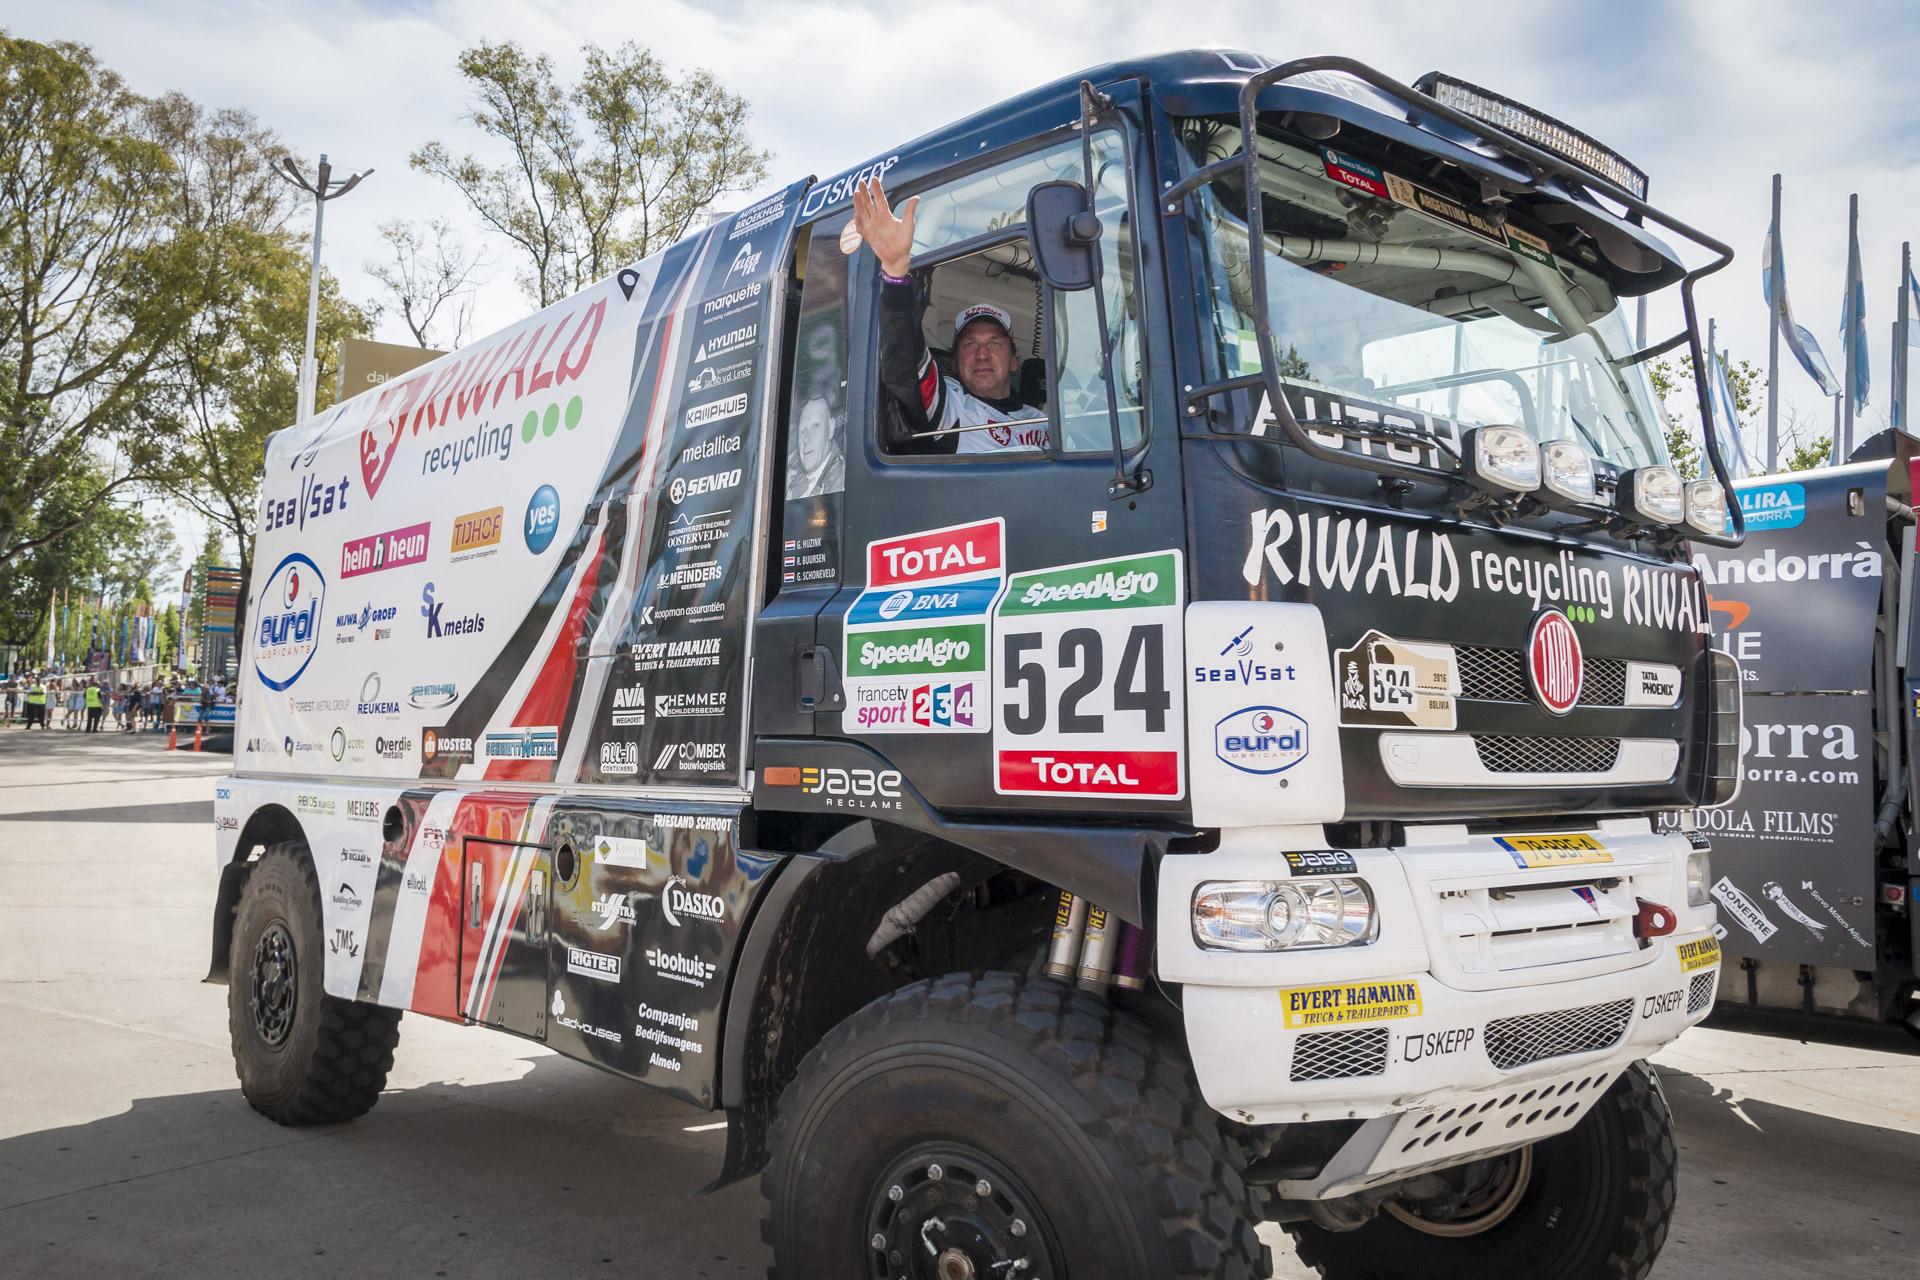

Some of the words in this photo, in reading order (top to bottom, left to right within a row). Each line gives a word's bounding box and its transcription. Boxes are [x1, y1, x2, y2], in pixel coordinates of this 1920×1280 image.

[1338, 169, 1375, 191] TOTAL
[734, 200, 785, 231] BROEKHUIS
[1418, 192, 1469, 224] ARGENTINA
[733, 251, 763, 272] KLEEN
[741, 262, 758, 277] TEC
[704, 282, 761, 315] marquette
[708, 324, 757, 352] HYUNDAI
[412, 296, 608, 437] RIWALD
[733, 367, 752, 378] Linde
[686, 397, 747, 426] KAMPHUIS
[422, 421, 514, 475] recycling
[682, 435, 741, 463] metallica
[687, 469, 742, 497] SENRO
[1731, 491, 1792, 511] LIRA
[454, 513, 501, 547] TIJHOF
[529, 503, 556, 535] yes
[667, 528, 722, 548] OOSTERVELD
[343, 546, 370, 573] hein
[388, 533, 425, 562] heun
[802, 553, 826, 565] BUURSEN
[883, 541, 986, 578] TOTAL
[1242, 508, 1460, 603] RIWALD
[1692, 542, 1882, 585] Andorrà
[669, 565, 723, 585] MEINDERS
[803, 568, 835, 580] SCHONEVELD
[1020, 571, 1159, 607] SpeedAgro
[1470, 550, 1614, 620] recycling
[1622, 564, 1712, 634] RIWAL
[911, 592, 960, 611] BNA
[260, 597, 318, 648] eurol
[372, 607, 397, 622] GROEP
[444, 613, 485, 637] metals
[632, 643, 667, 660] EVERT
[668, 638, 721, 657] HAMMINK
[860, 638, 970, 670] SpeedAgro
[641, 661, 658, 671] TRUCK
[666, 657, 712, 668] TRAILERPARTS
[1539, 621, 1575, 703] TATRA
[1004, 624, 1171, 735] 524
[1373, 669, 1413, 705] 524
[1433, 673, 1446, 683] 2016
[1641, 671, 1659, 681] TATRA
[668, 692, 727, 707] HEMMER
[857, 685, 908, 702] francetv
[1642, 682, 1674, 696] PHOENIX
[357, 702, 400, 714] REUKEMA
[668, 706, 726, 715] SCHILDERSBEDRIJF
[857, 701, 907, 728] sport
[915, 693, 931, 720] 2
[936, 692, 951, 719] 3
[956, 691, 973, 719] 4
[1429, 700, 1449, 710] BOLIVIA
[376, 736, 411, 755] Overdie
[437, 737, 472, 751] KOSTER
[679, 742, 726, 760] COMBEX
[1224, 729, 1301, 752] eurol
[383, 751, 403, 760] metals
[679, 760, 726, 773] bouwlogistiek
[1031, 757, 1139, 786] TOTAL
[347, 800, 380, 817] MEIJERS
[826, 798, 902, 810] RECLAME
[653, 814, 695, 829] FRIESLAND
[696, 817, 732, 832] SCHROOT
[1763, 810, 1834, 835] FILMS
[1760, 835, 1834, 843] gondolafilms.com
[407, 874, 428, 891] elliott
[333, 895, 349, 906] Building
[349, 896, 362, 907] Design
[672, 890, 725, 918] DASKO
[1717, 882, 1772, 937] DONERRE
[1810, 889, 1829, 909] Servo
[1828, 906, 1850, 930] Motors
[1848, 927, 1870, 947] Adjust
[335, 928, 354, 951] TMS
[571, 951, 617, 973] RIGTER
[657, 948, 705, 978] loohuis
[1290, 988, 1342, 1011] EVERT
[1347, 983, 1416, 1005] HAMMINK
[1655, 989, 1684, 1015] SKEPP
[638, 1002, 699, 1031] Companjen
[1304, 1011, 1334, 1024] TRUCK
[1336, 1010, 1344, 1021] &
[1346, 1004, 1409, 1021] TRAILERPARTS
[635, 1024, 703, 1054] Bedrijfswagens
[1425, 1027, 1475, 1056] SKEPP
[650, 1052, 681, 1072] Almelo
